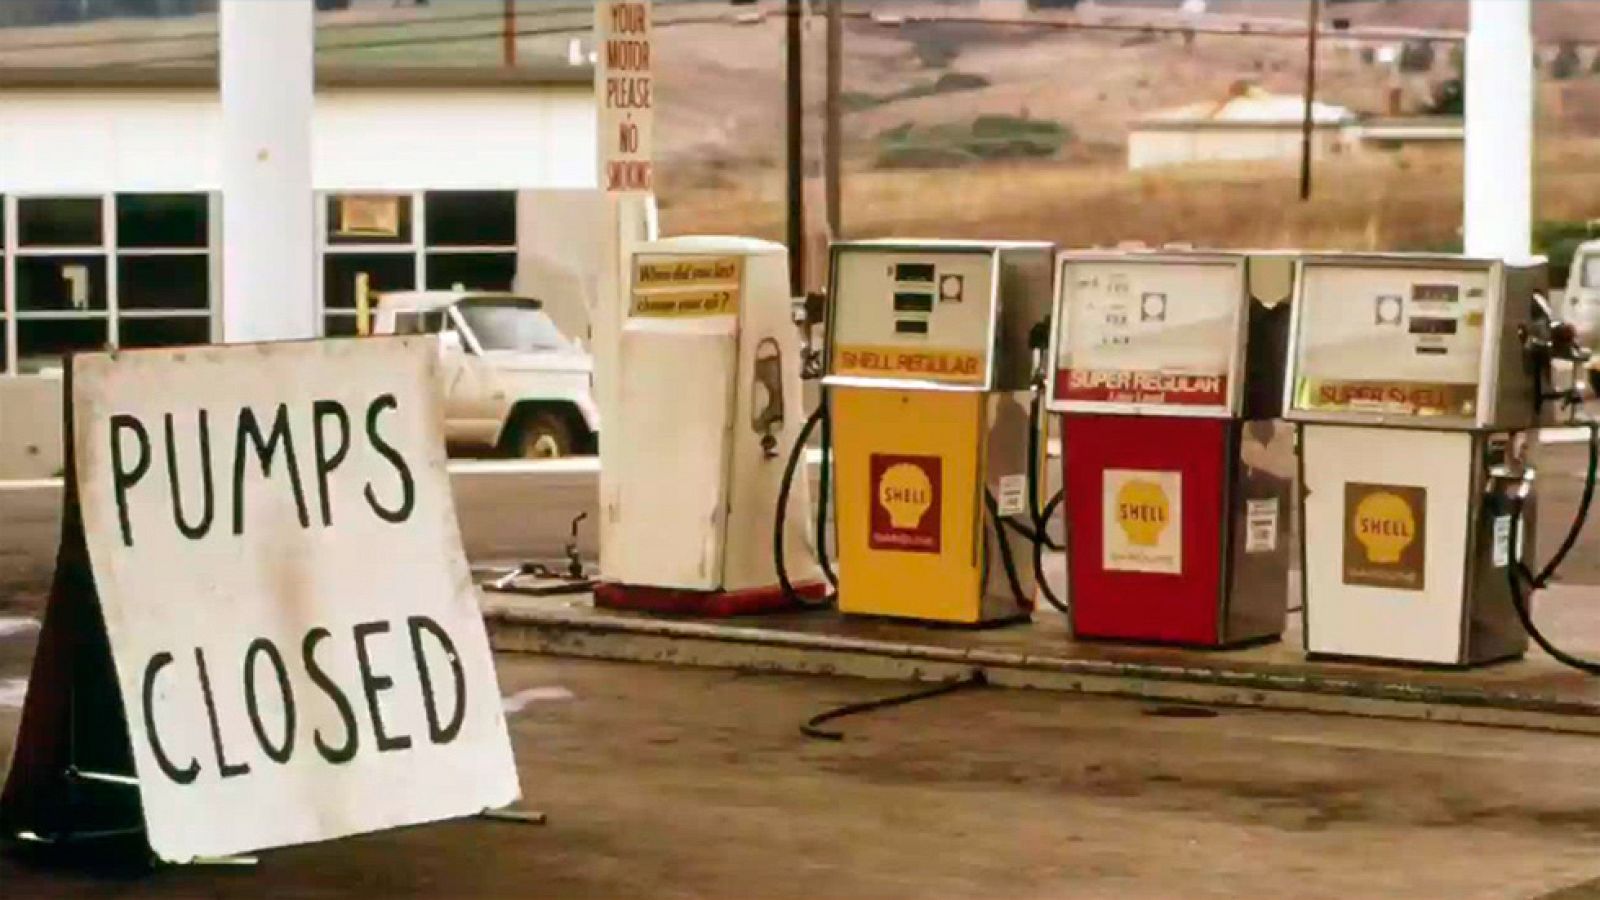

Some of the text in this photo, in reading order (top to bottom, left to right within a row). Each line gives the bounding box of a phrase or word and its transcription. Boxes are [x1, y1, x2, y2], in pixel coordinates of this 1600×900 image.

[611, 4, 645, 33] YOUR
[606, 40, 650, 70] MOTOR
[606, 77, 651, 109] PLEASE
[619, 123, 637, 152] NO
[606, 161, 651, 191] SMOKING
[841, 351, 979, 375] SHELL REGULAR
[1069, 370, 1221, 393] SUPER REGULAR
[1319, 383, 1382, 403] SUPER
[110, 394, 415, 547] PUMPS
[884, 487, 925, 504] SHELL
[1119, 503, 1165, 522] SHELL
[1361, 518, 1409, 537] SHELL
[142, 615, 467, 785] CLOSED
